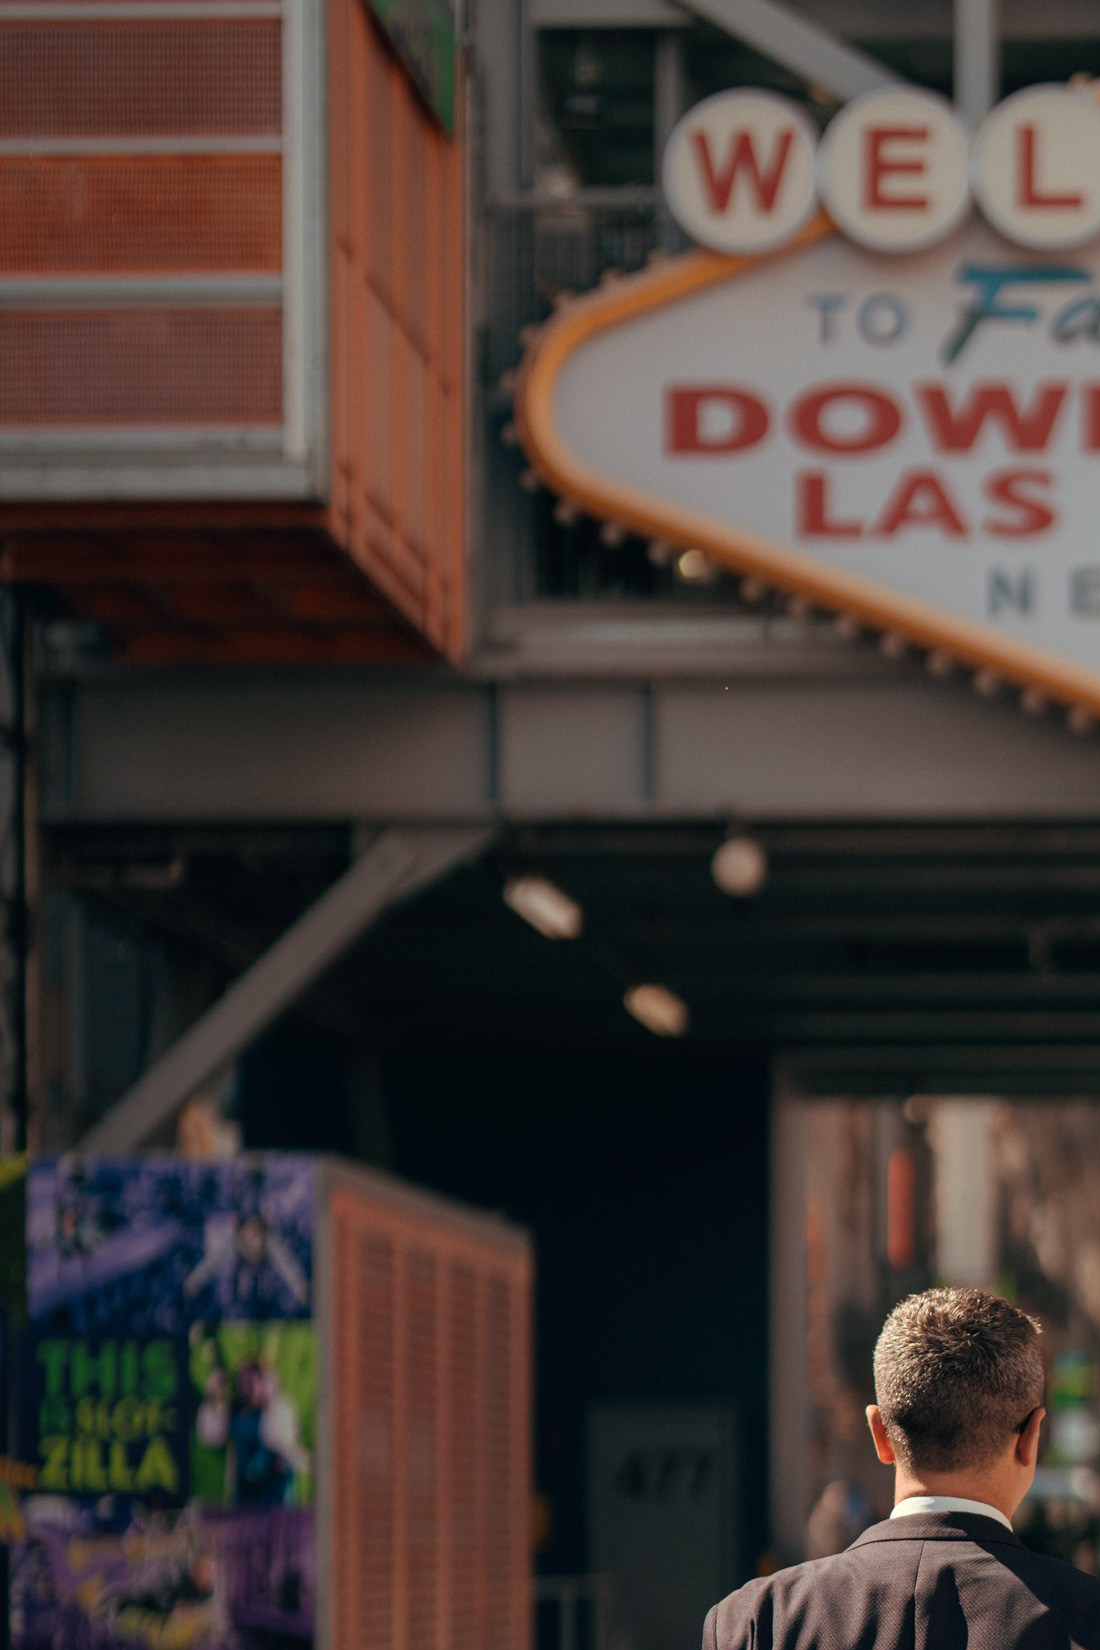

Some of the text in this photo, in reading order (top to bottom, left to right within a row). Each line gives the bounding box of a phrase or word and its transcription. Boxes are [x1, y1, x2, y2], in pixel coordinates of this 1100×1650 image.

[802, 294, 909, 350] TO
[797, 466, 1061, 541] LAS
[36, 1338, 178, 1399] THIS
[38, 1436, 178, 1493] ZILLA
